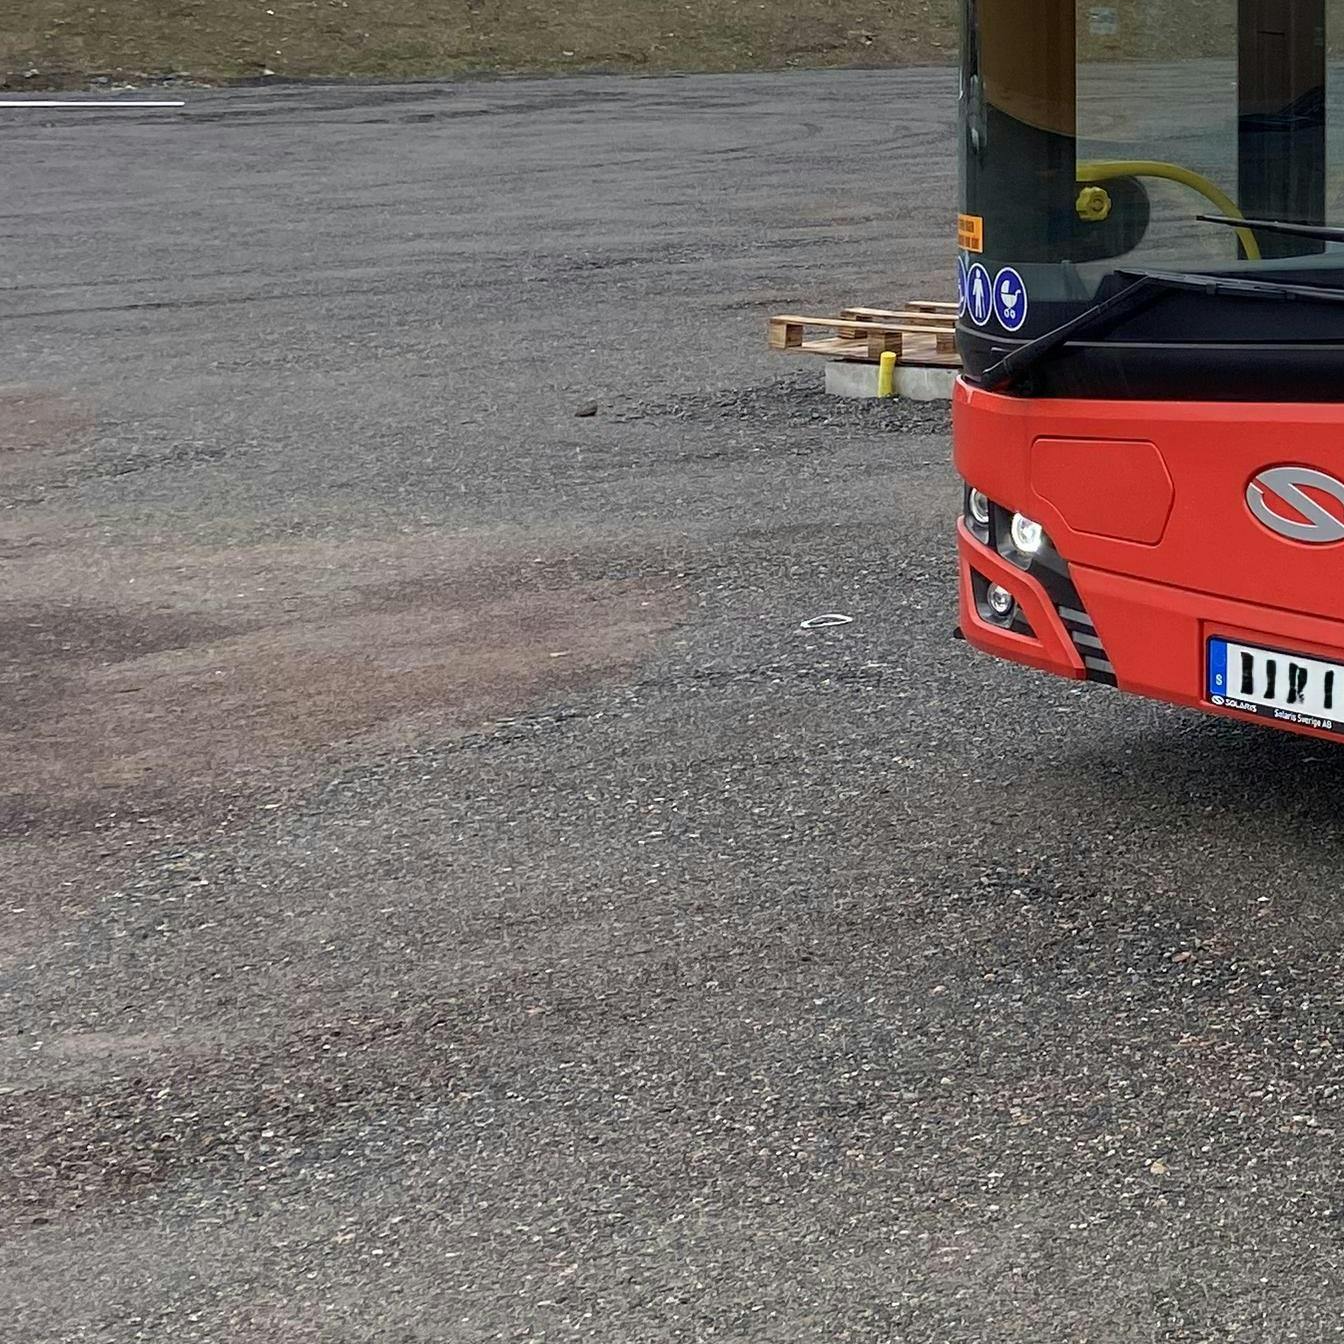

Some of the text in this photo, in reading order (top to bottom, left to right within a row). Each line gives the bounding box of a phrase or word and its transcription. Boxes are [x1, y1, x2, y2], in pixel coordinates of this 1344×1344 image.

[1215, 673, 1223, 686] S
[1224, 698, 1258, 713] SOLARIS
[1273, 708, 1332, 729] Solaris Sverige AB
